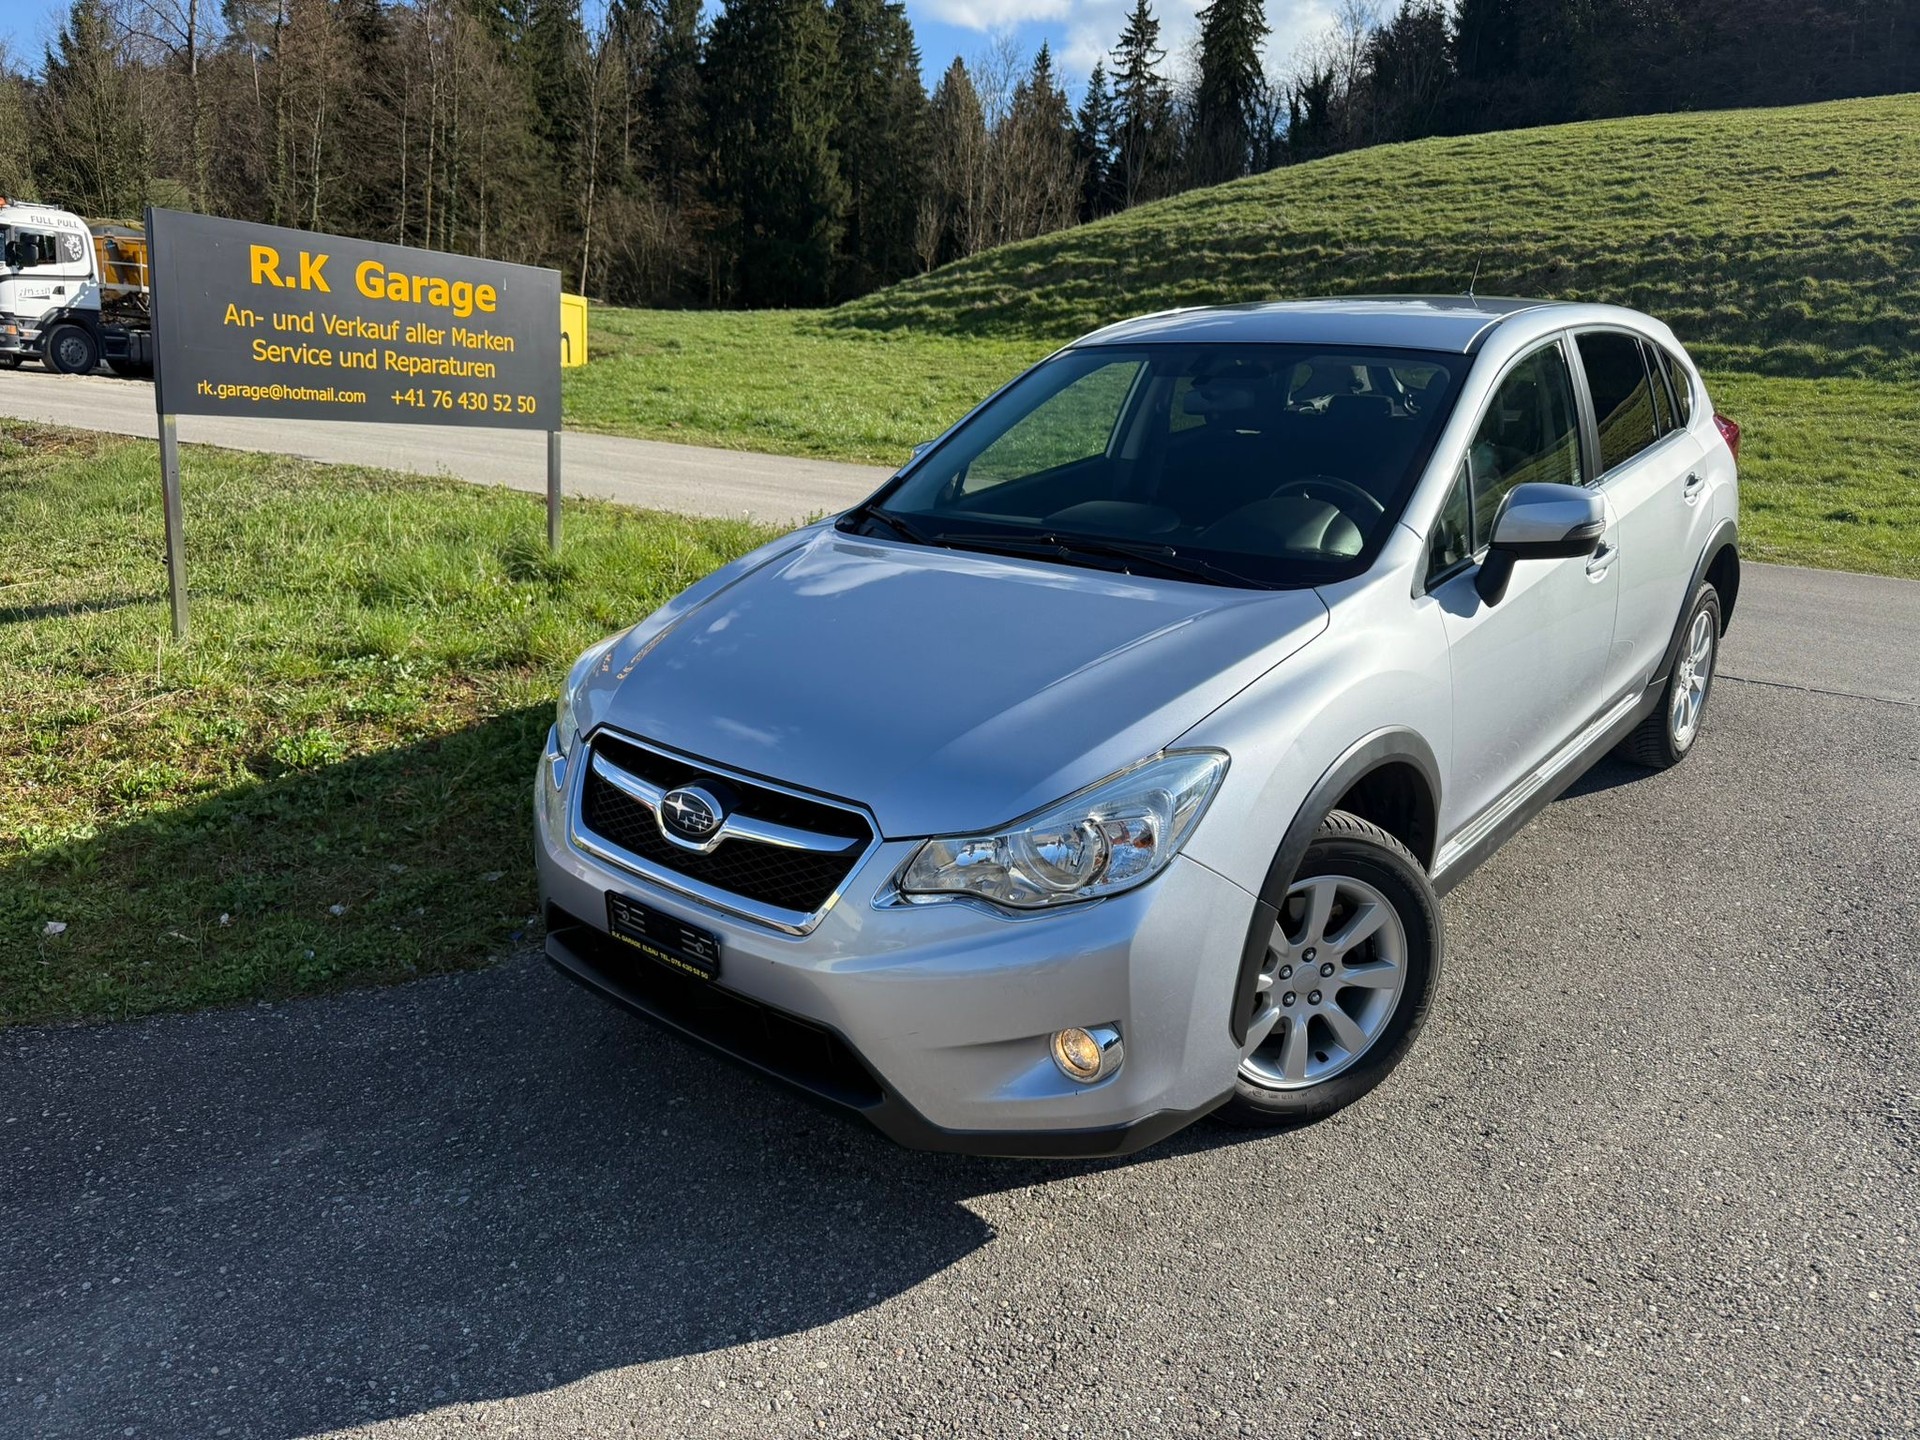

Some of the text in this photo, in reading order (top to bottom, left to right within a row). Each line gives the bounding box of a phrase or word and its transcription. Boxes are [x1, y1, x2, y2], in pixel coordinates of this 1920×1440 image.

[31, 215, 79, 229] FULL PULL
[249, 243, 498, 319] R.K Garage
[223, 303, 516, 353] An- und Verkauf aller Marken
[252, 338, 497, 379] Service und Reparaturen
[197, 380, 537, 415] rk.garage@hotmail.com +41 76 430 52 50
[621, 935, 642, 949] GARAGE
